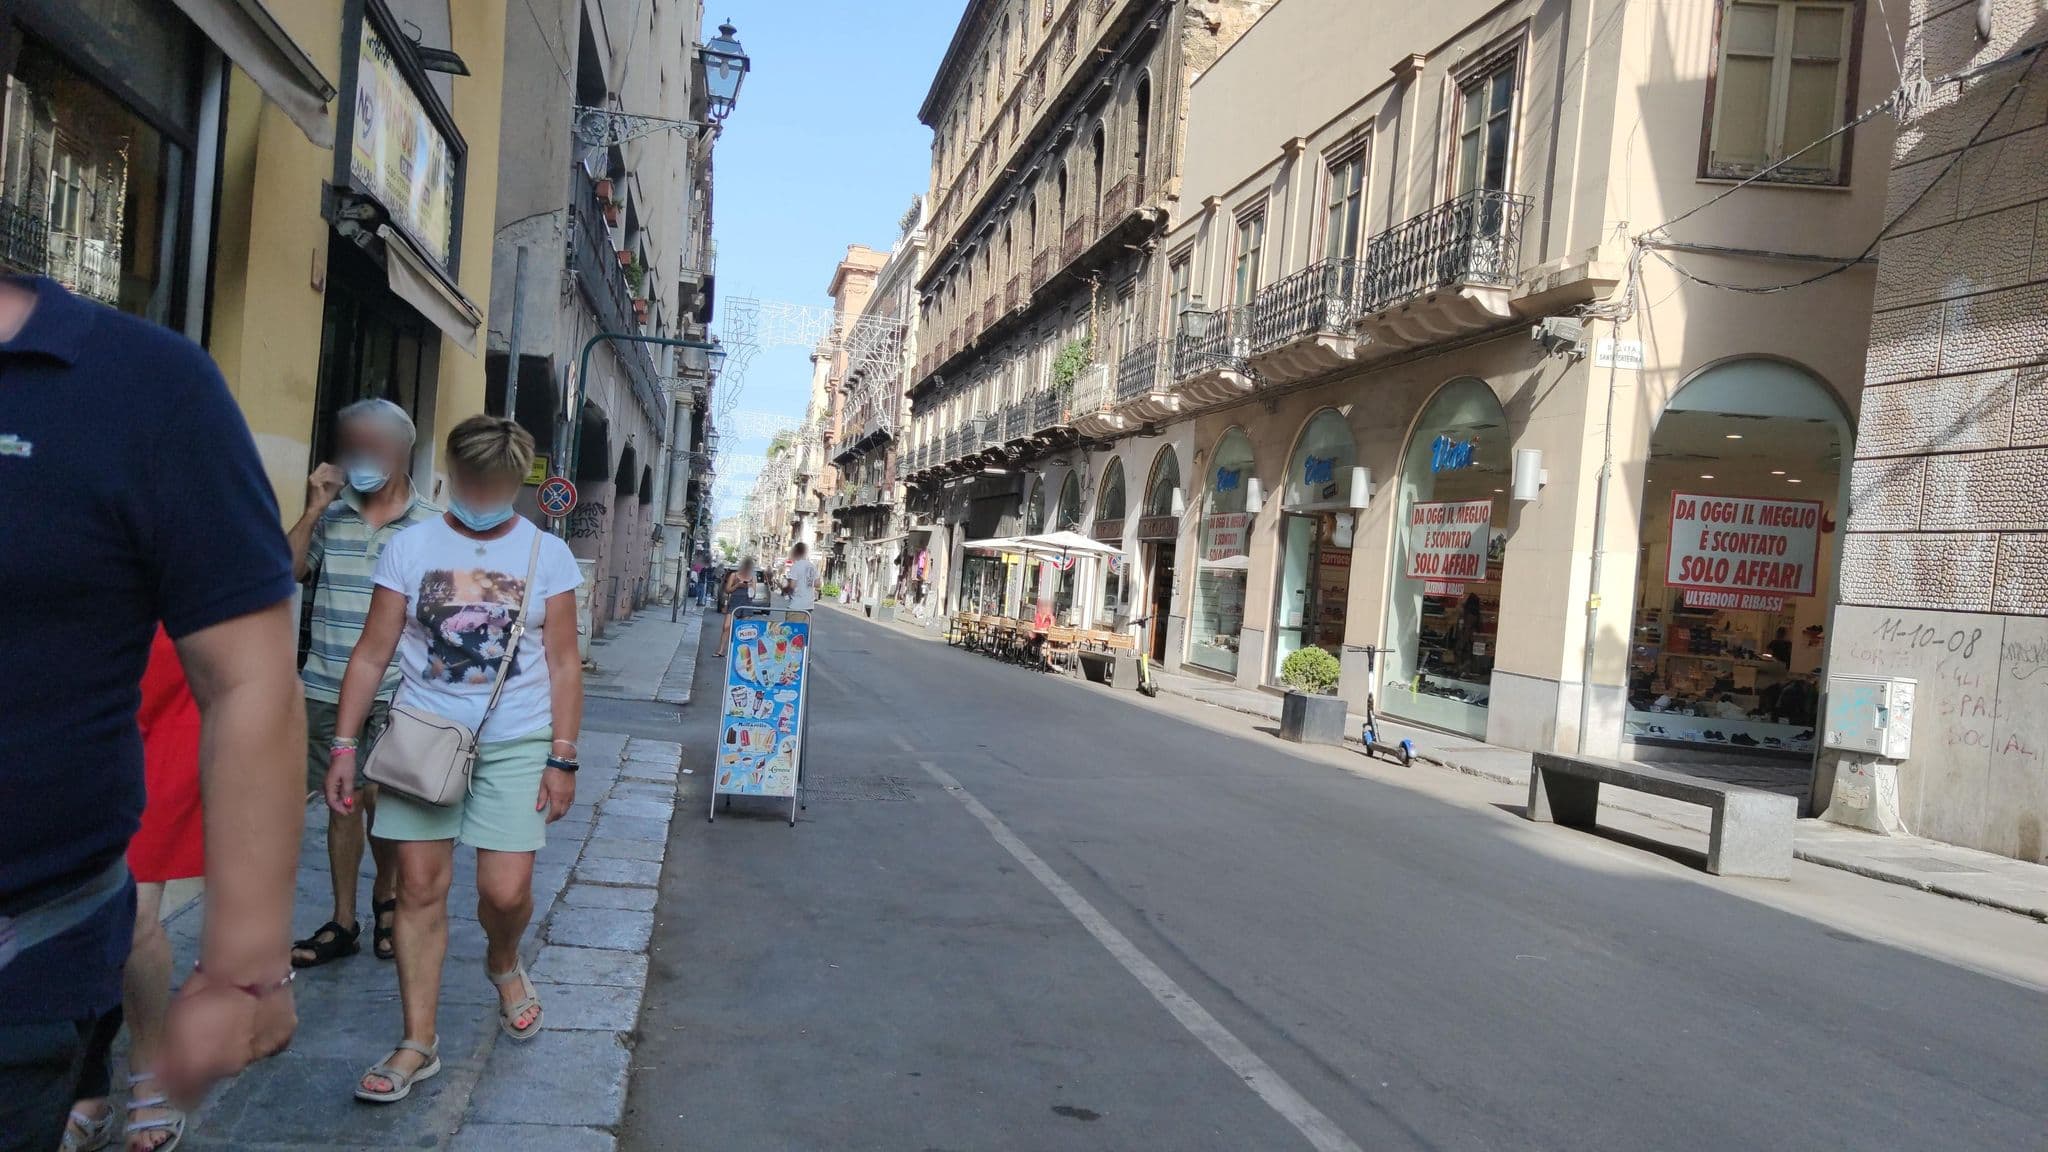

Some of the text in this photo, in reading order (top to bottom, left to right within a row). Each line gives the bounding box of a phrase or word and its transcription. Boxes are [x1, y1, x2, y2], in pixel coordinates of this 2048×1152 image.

[1414, 505, 1489, 525] DA OGGI IL MEGLIO
[1675, 500, 1816, 529] DA OGGI IL MEGLIO
[1431, 531, 1472, 549] SCONTATO
[1699, 524, 1787, 556] È SCONTATO
[1414, 552, 1440, 574] SOLO
[1441, 553, 1480, 576] AFFARI
[1678, 555, 1803, 589] SOLO AFFARI
[1685, 590, 1782, 612] ULTERIORI RIBASSI
[1873, 618, 1982, 659] 11-10-08
